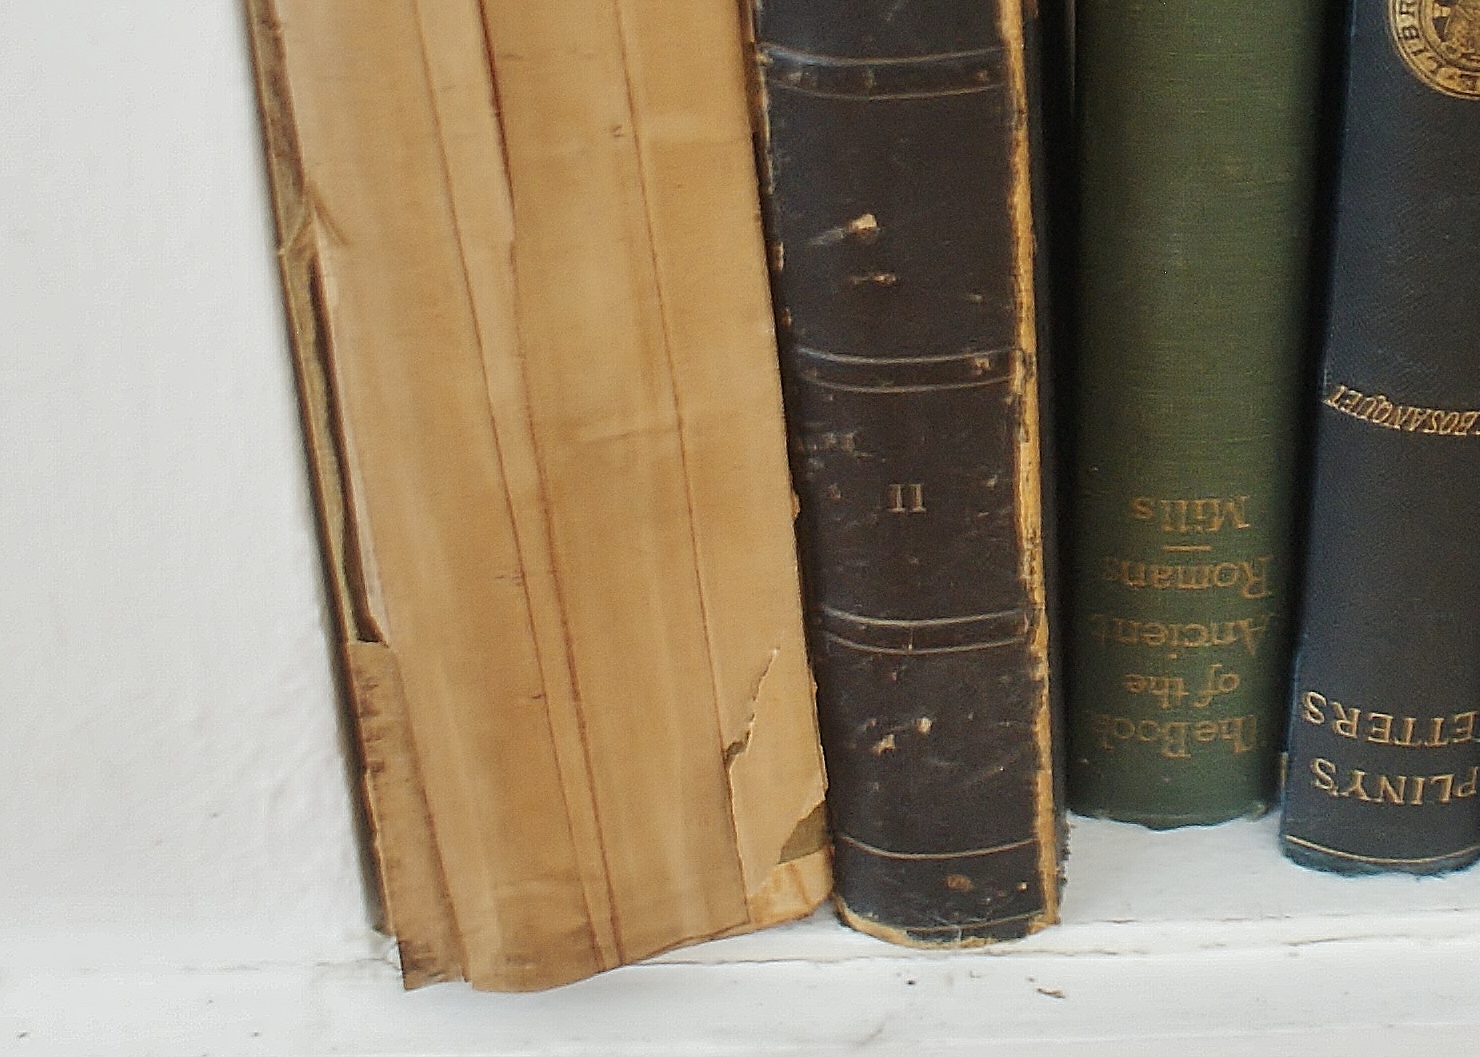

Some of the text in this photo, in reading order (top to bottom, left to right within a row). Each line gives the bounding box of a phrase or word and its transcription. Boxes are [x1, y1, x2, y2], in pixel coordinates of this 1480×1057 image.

[887, 483, 927, 514] II
[1131, 495, 1250, 532] Mills
[1100, 555, 1273, 599] Romans
[1123, 664, 1240, 710] of the
[1310, 758, 1479, 805] PLINY'S
